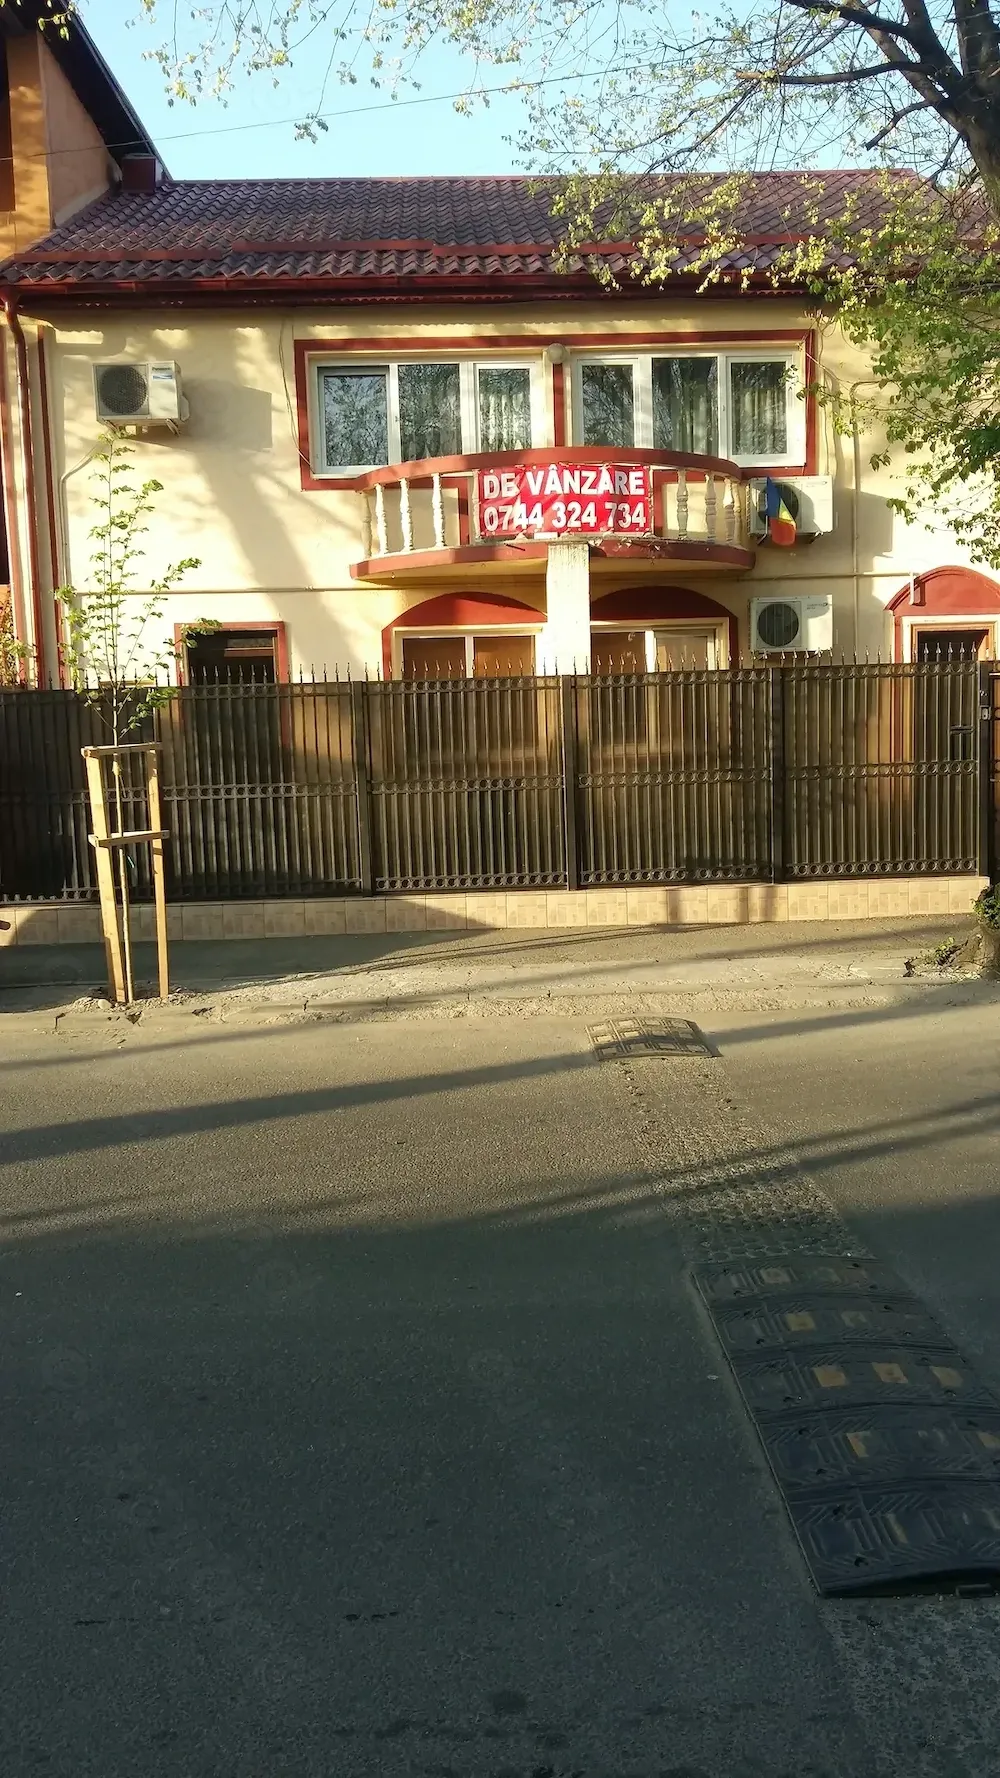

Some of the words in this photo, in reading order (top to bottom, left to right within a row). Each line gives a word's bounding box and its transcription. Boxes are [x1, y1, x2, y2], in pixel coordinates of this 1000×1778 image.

[483, 472, 520, 499] DE
[526, 464, 645, 496] VÂNZARE
[484, 501, 544, 531] 0744
[552, 501, 597, 528] 324
[605, 501, 646, 528] 734
